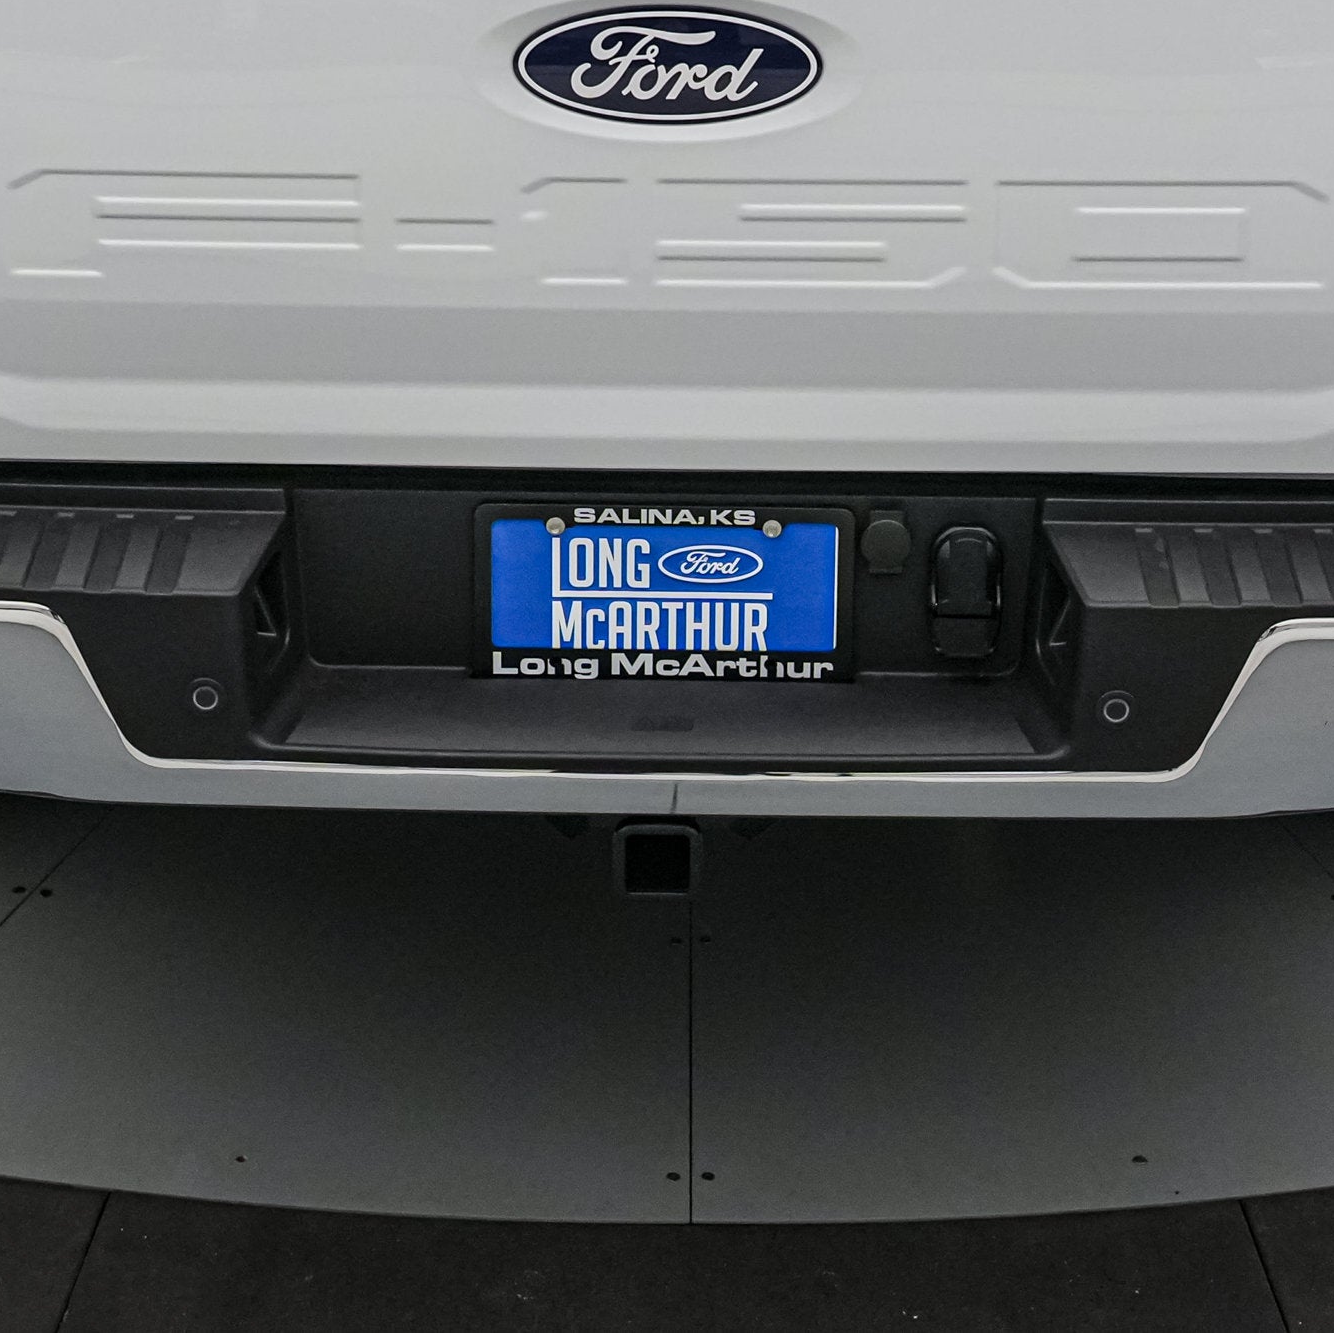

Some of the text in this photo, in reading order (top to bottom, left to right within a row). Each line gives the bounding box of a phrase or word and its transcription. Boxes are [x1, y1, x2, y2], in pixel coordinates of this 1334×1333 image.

[570, 25, 764, 101] Ford
[710, 509, 756, 526] KS
[551, 537, 739, 597] LONG Ford
[551, 600, 768, 651] McARTHUR
